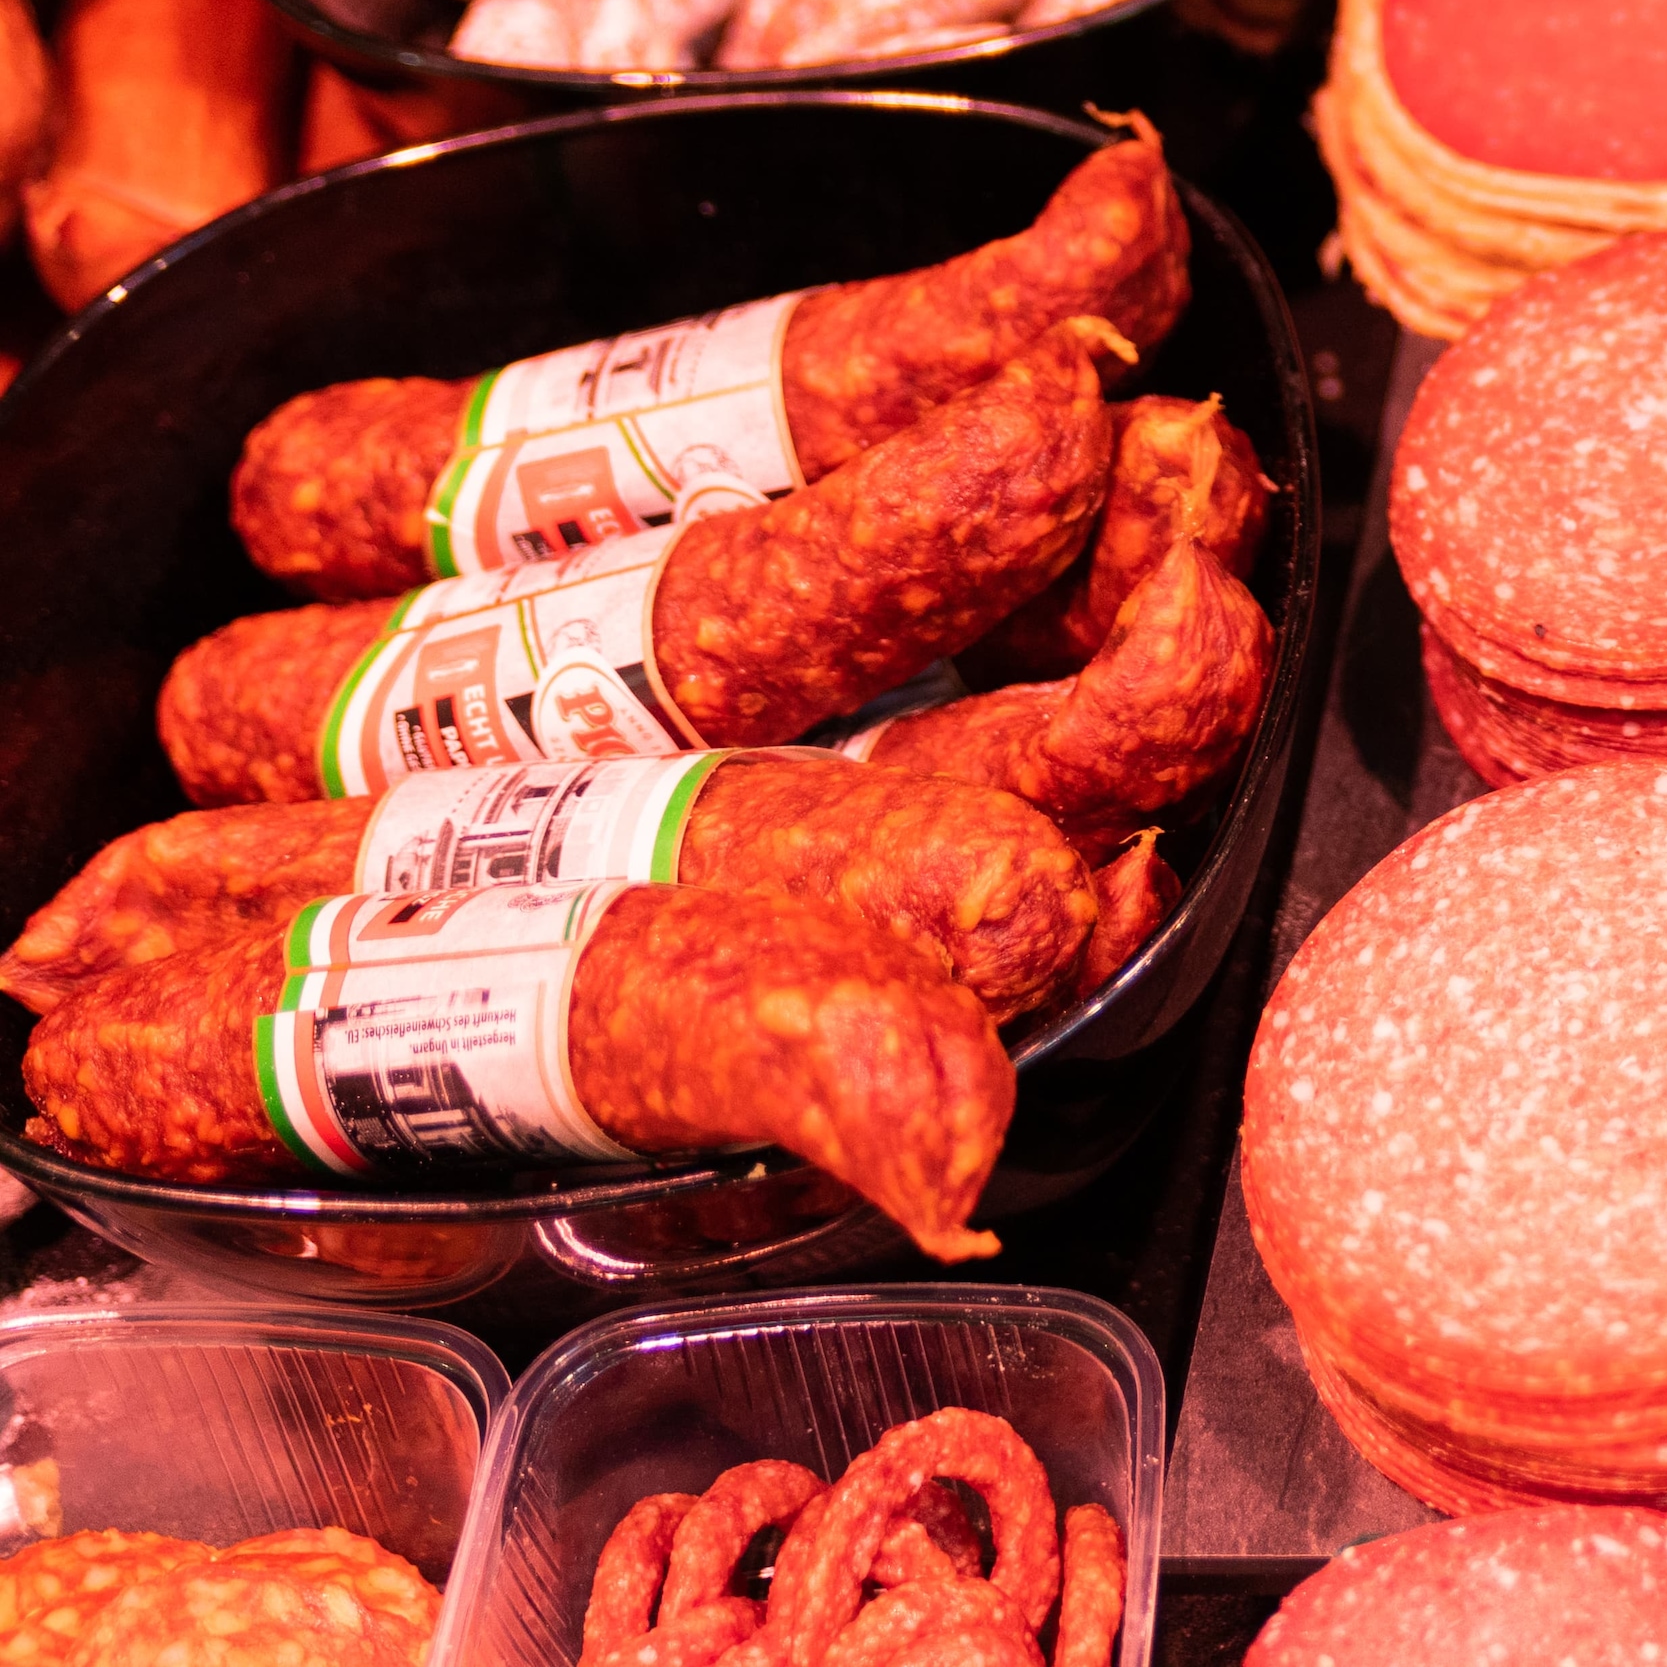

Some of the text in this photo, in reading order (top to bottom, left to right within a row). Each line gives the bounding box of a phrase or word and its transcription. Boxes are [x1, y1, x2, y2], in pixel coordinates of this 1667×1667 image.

[463, 683, 500, 749] ECHT
[345, 1009, 516, 1044] Herkunft des Schweinefleisches: EU.
[410, 1031, 516, 1055] Hergestellt in Ungarn.
